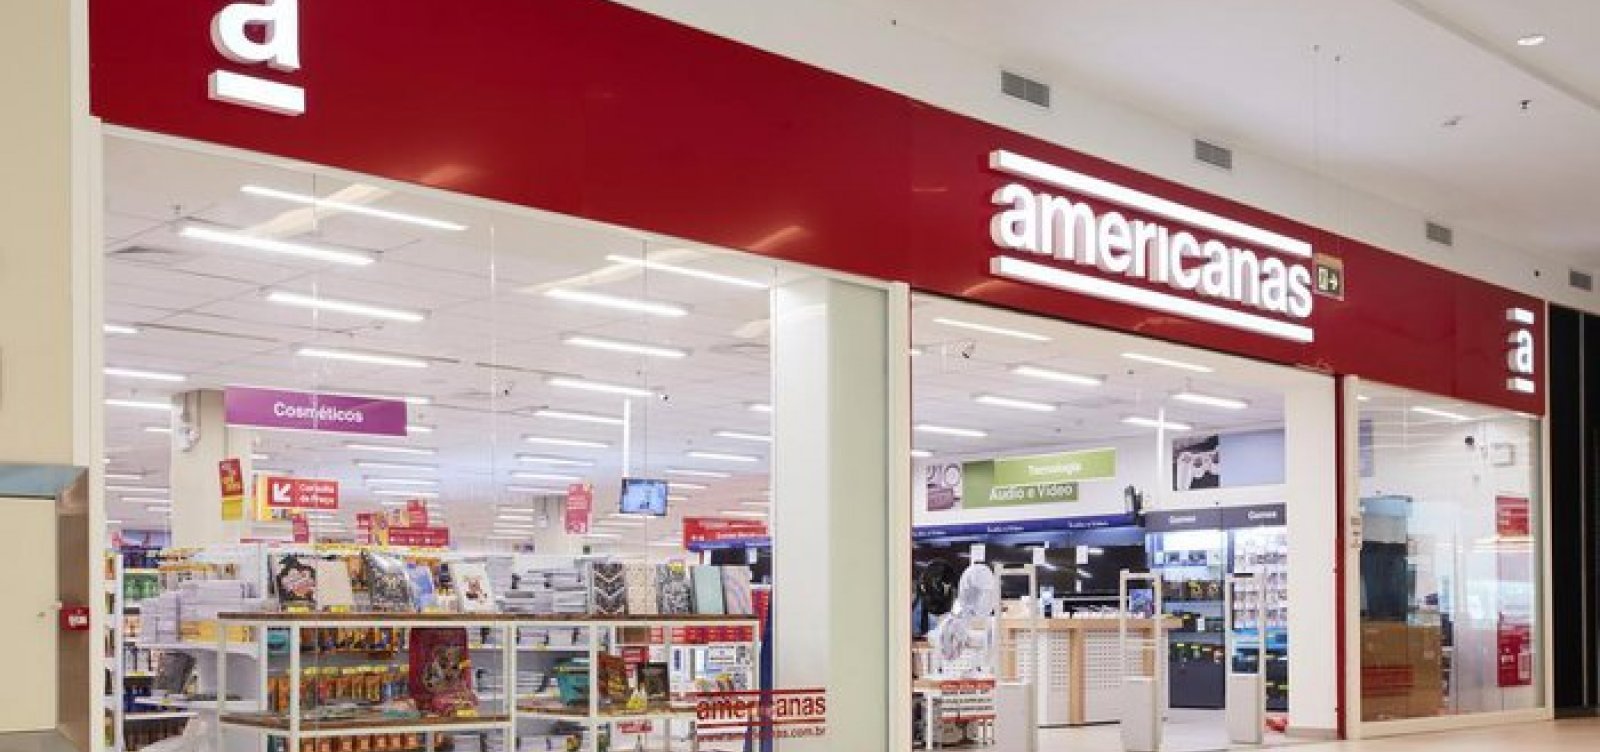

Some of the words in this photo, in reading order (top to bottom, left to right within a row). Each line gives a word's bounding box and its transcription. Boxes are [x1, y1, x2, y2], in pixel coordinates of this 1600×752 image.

[211, 0, 301, 73] a
[990, 182, 1313, 318] americanas
[1507, 329, 1535, 375] a
[273, 402, 364, 423] Cosméticos
